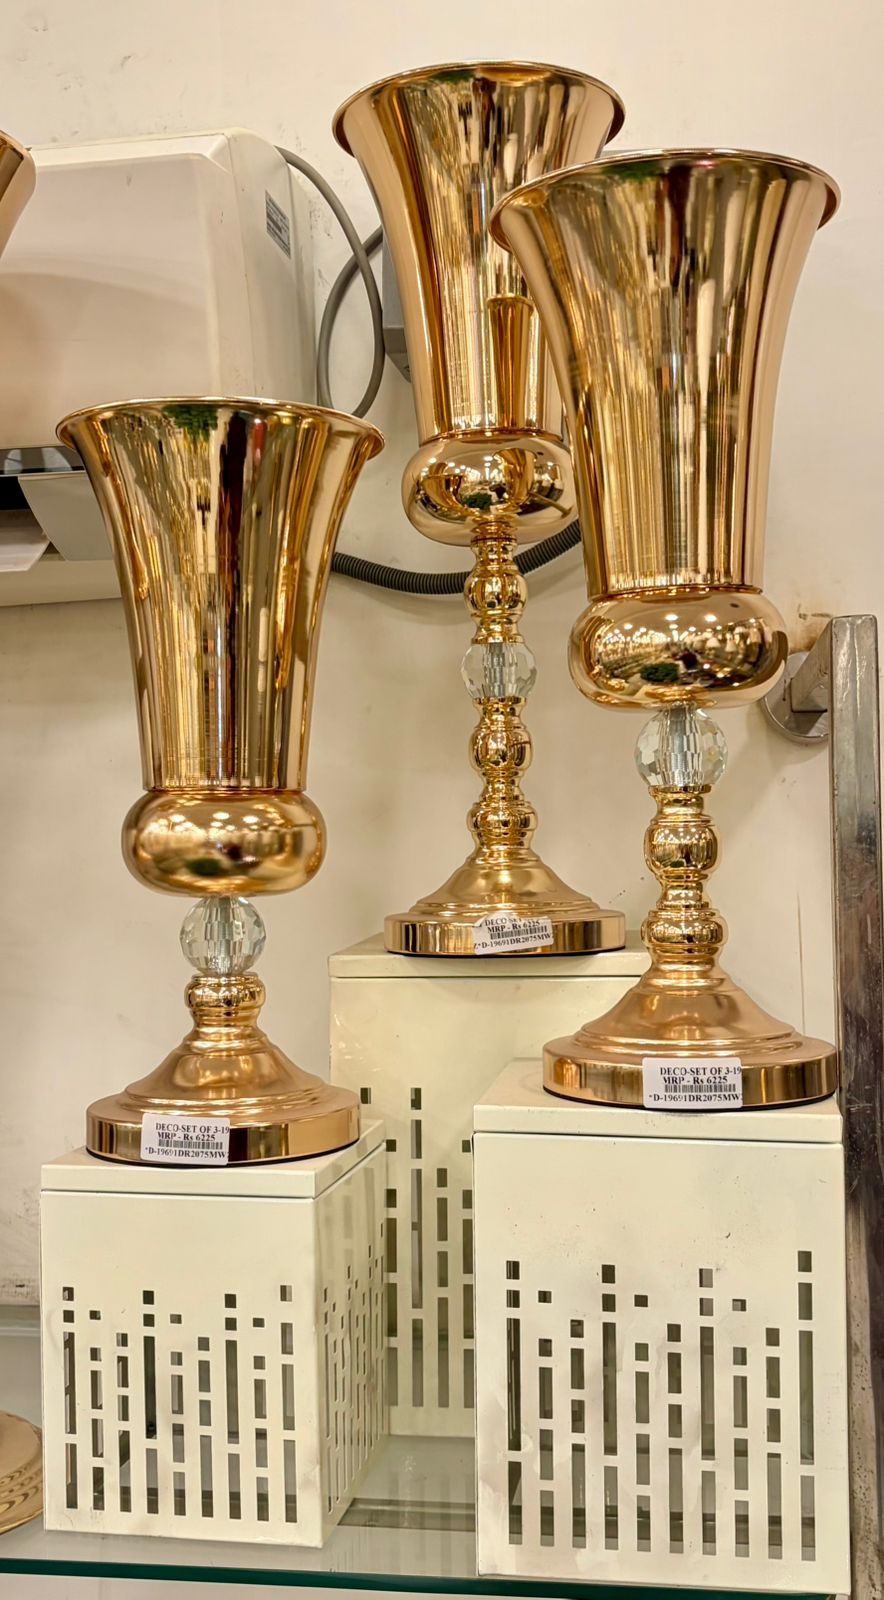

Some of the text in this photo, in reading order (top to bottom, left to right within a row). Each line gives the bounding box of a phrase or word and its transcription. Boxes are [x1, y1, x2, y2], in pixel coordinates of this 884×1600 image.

[487, 924, 506, 933] MRP
[523, 920, 540, 928] 6225
[660, 1067, 708, 1076] DECO-SET
[709, 1067, 723, 1076] OF
[663, 1076, 685, 1084] MRP
[693, 1076, 704, 1084] Rs
[706, 1075, 728, 1084] 6225
[649, 1093, 742, 1102] D-19691DR2075MW
[155, 1122, 230, 1134] DECO-SET OF 3-19
[157, 1131, 177, 1140] MRP
[183, 1133, 193, 1141] Rs
[195, 1133, 216, 1142] 6225
